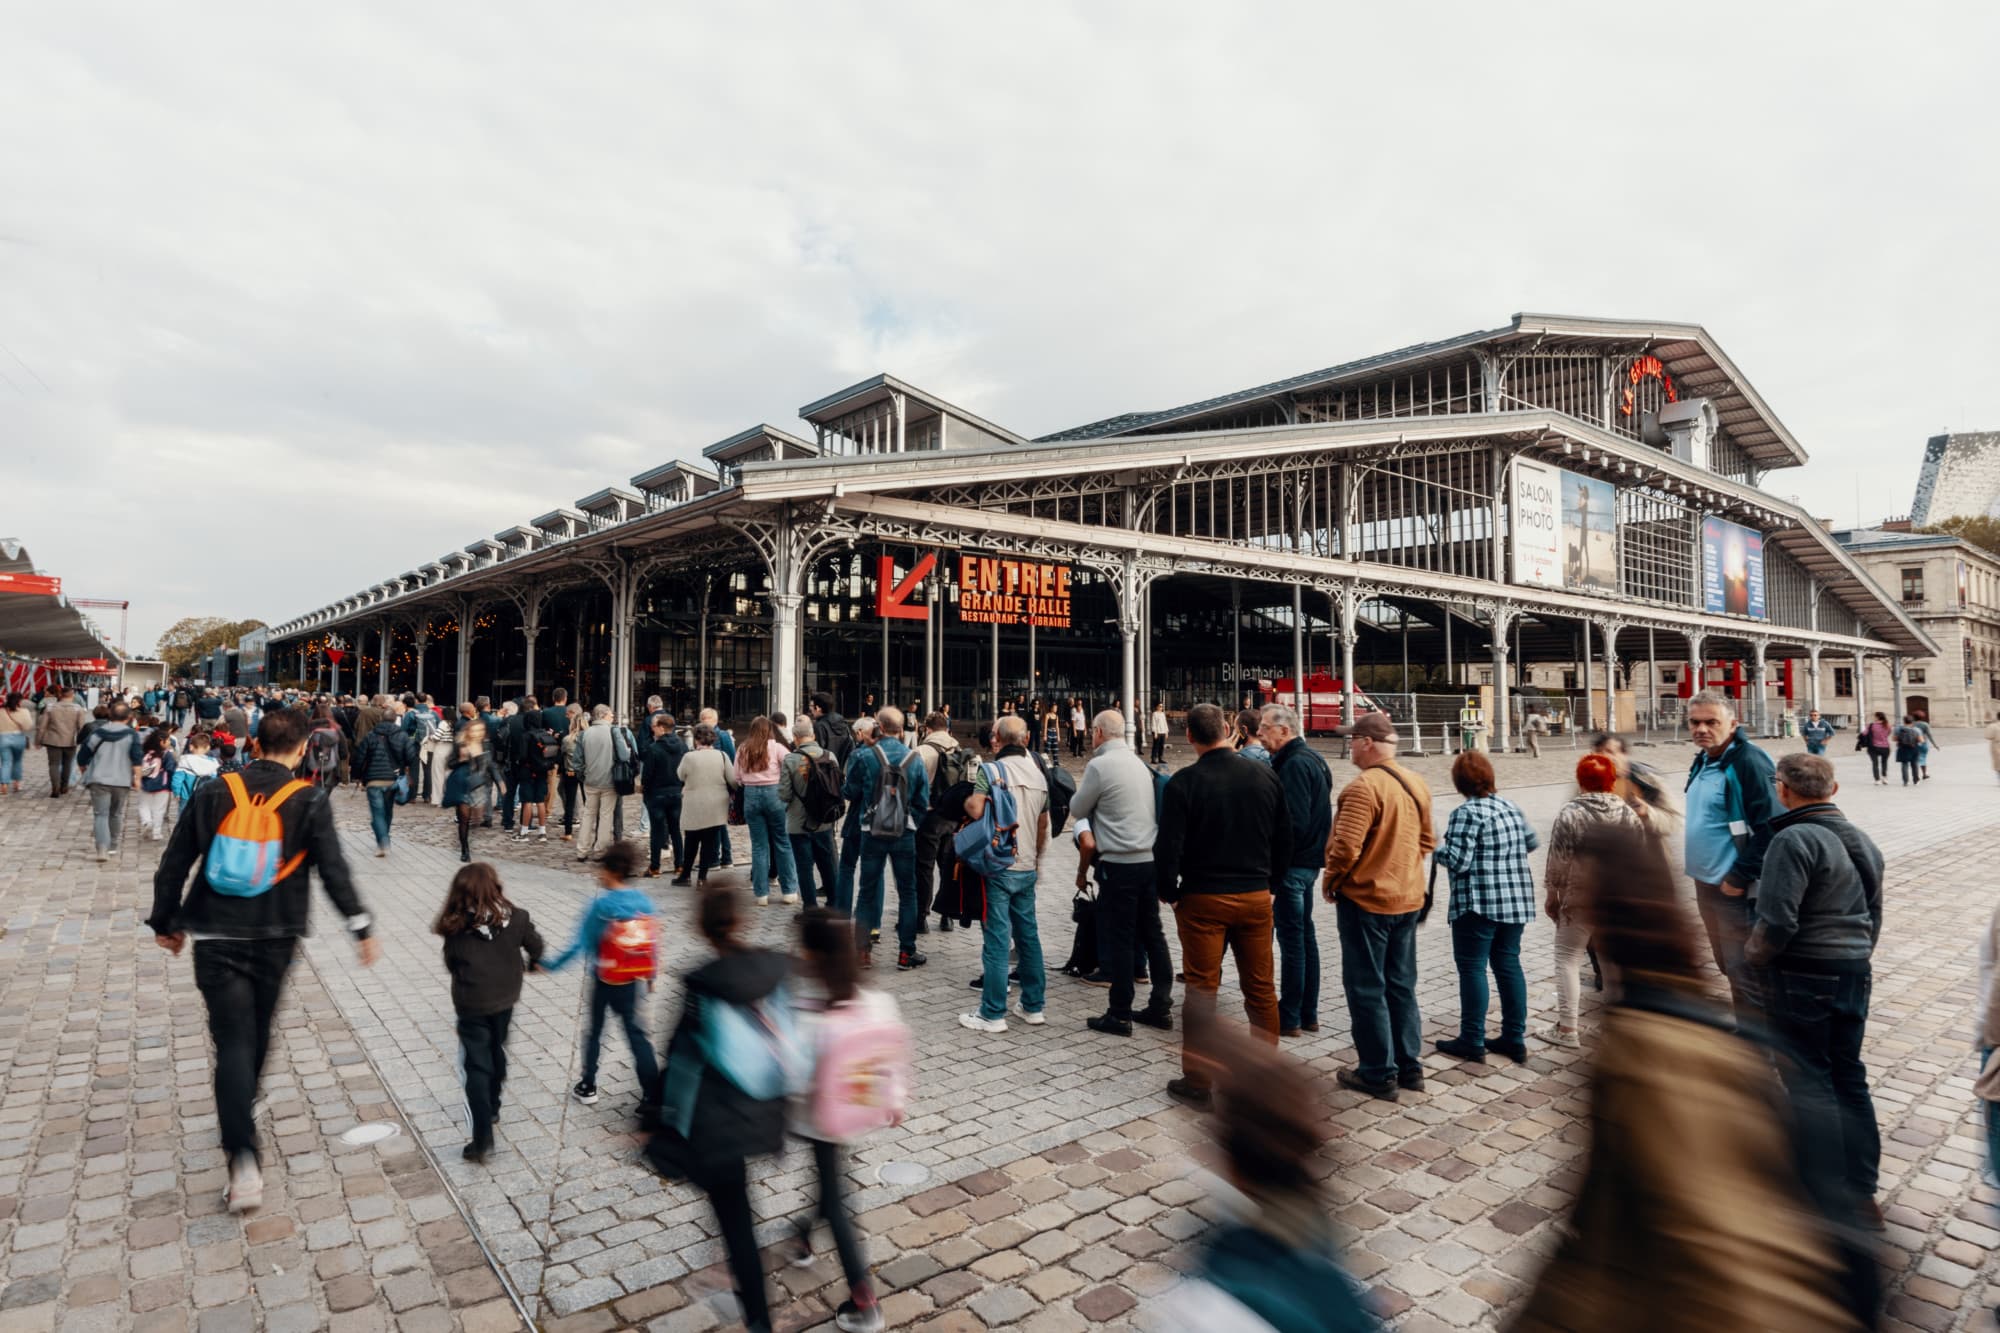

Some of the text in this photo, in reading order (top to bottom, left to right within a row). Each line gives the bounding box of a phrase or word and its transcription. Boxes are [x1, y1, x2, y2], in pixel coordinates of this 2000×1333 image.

[1621, 356, 1663, 415] LA GRANDE
[1520, 481, 1553, 504] SALON
[1521, 508, 1553, 531] PHOTO
[961, 556, 1071, 597] ENTREE
[961, 592, 1071, 616] GRANDE HALLE
[961, 610, 1071, 628] RESTAURANT LIBRAIRIE
[1222, 662, 1284, 681] Biletterie
